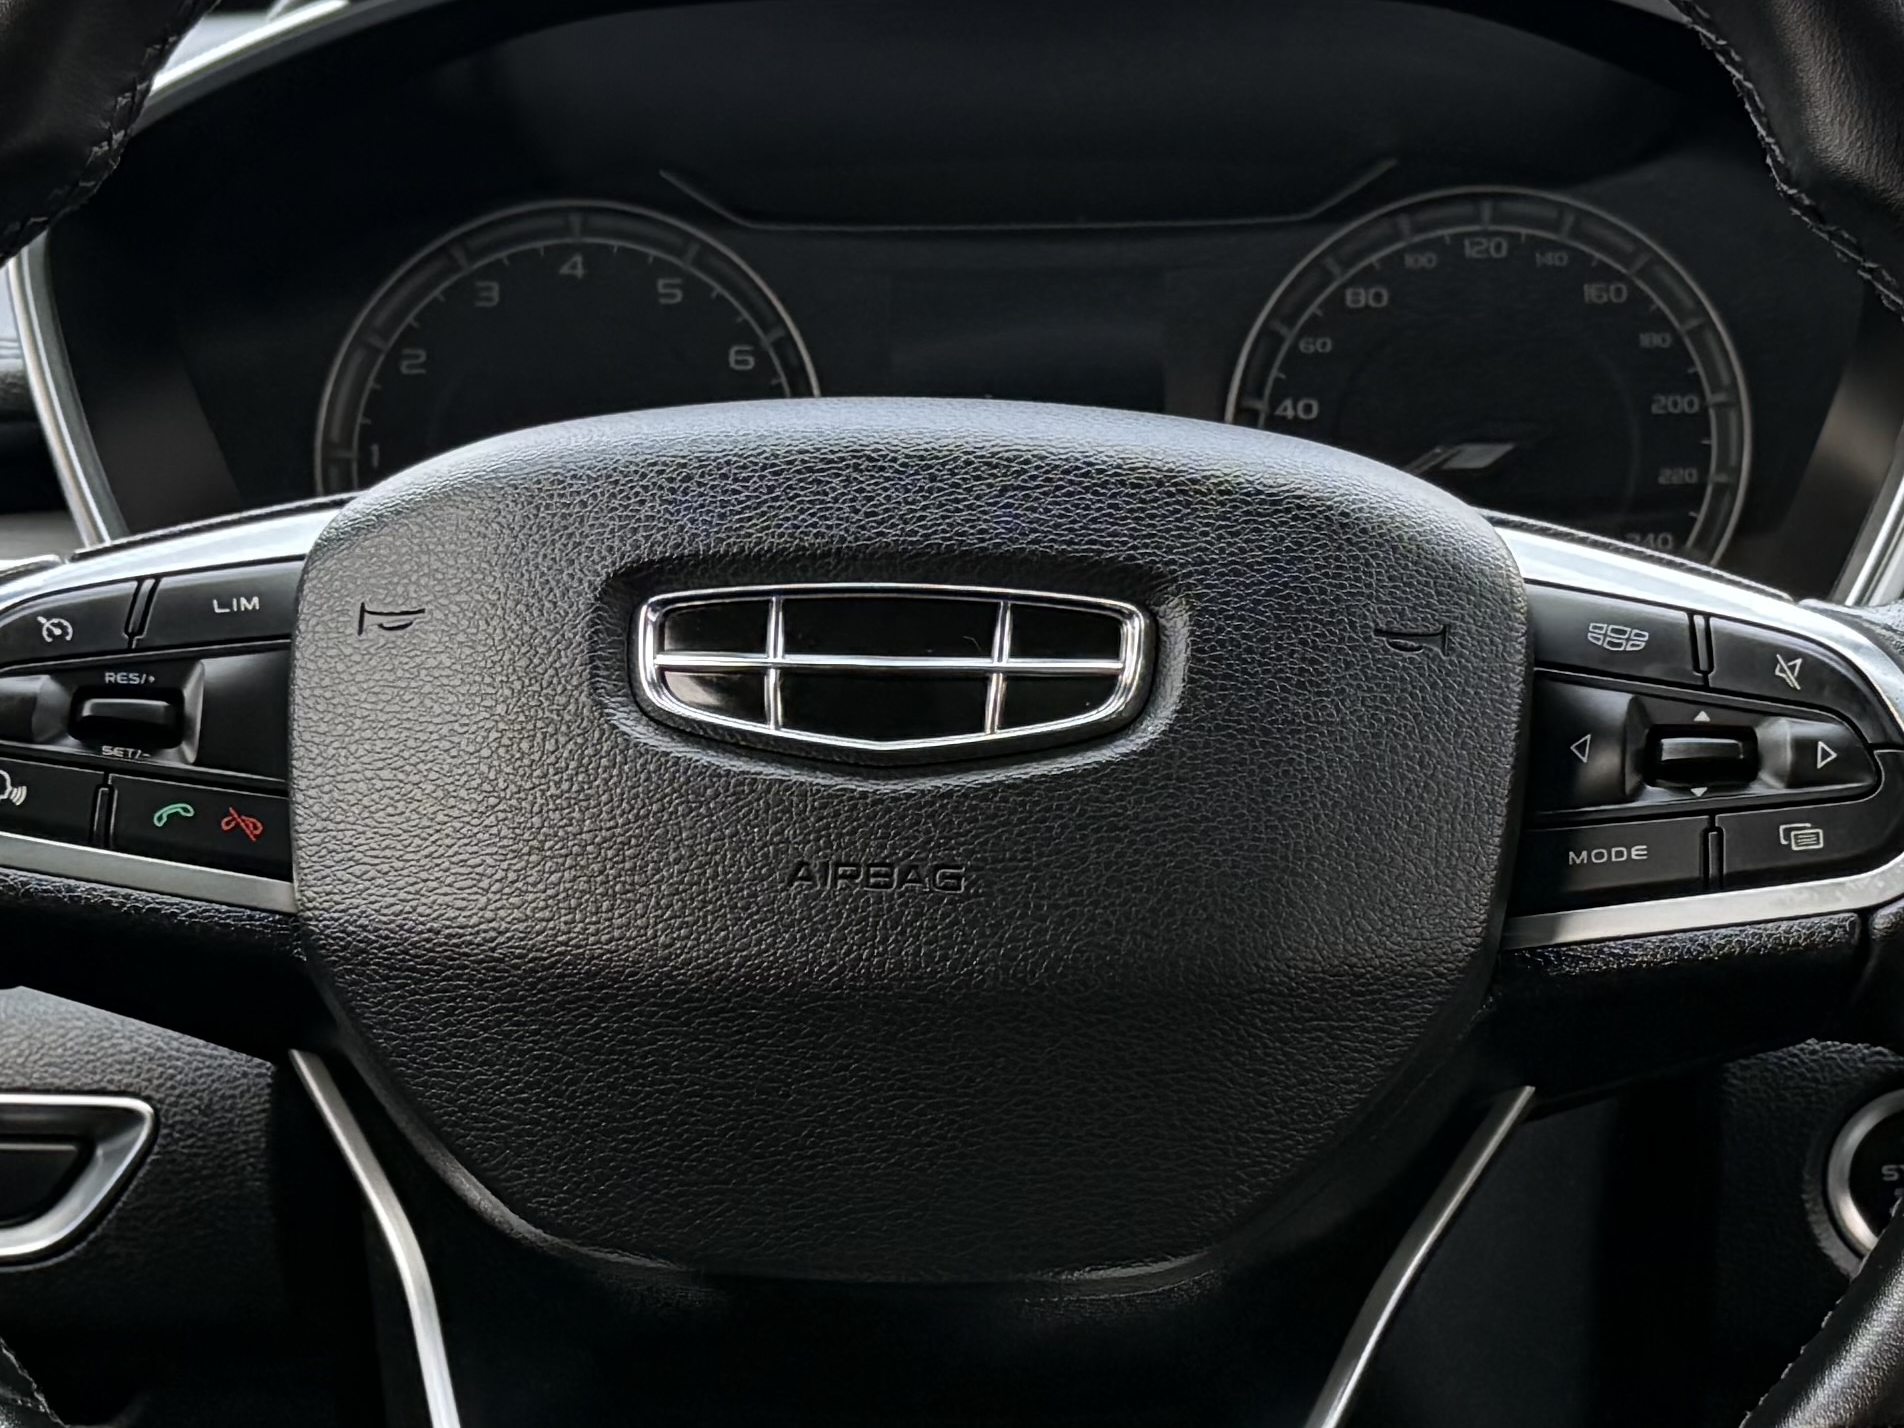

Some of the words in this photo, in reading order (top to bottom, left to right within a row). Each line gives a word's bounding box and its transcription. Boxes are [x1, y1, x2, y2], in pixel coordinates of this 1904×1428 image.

[1463, 237, 1508, 258] 120
[559, 254, 585, 278] 4
[1403, 252, 1437, 268] 100
[1534, 251, 1568, 267] 140
[474, 281, 499, 307] 3
[656, 279, 683, 304] 5
[1344, 286, 1388, 309] 80
[1582, 282, 1627, 305] 160
[1298, 336, 1332, 355] 60
[399, 349, 427, 374] 2
[728, 345, 756, 370] 6
[1274, 398, 1319, 420] 40
[1650, 394, 1700, 415] 200
[212, 595, 260, 614] LIM
[1568, 844, 1649, 865] MODE
[790, 861, 966, 893] AIRBAG
